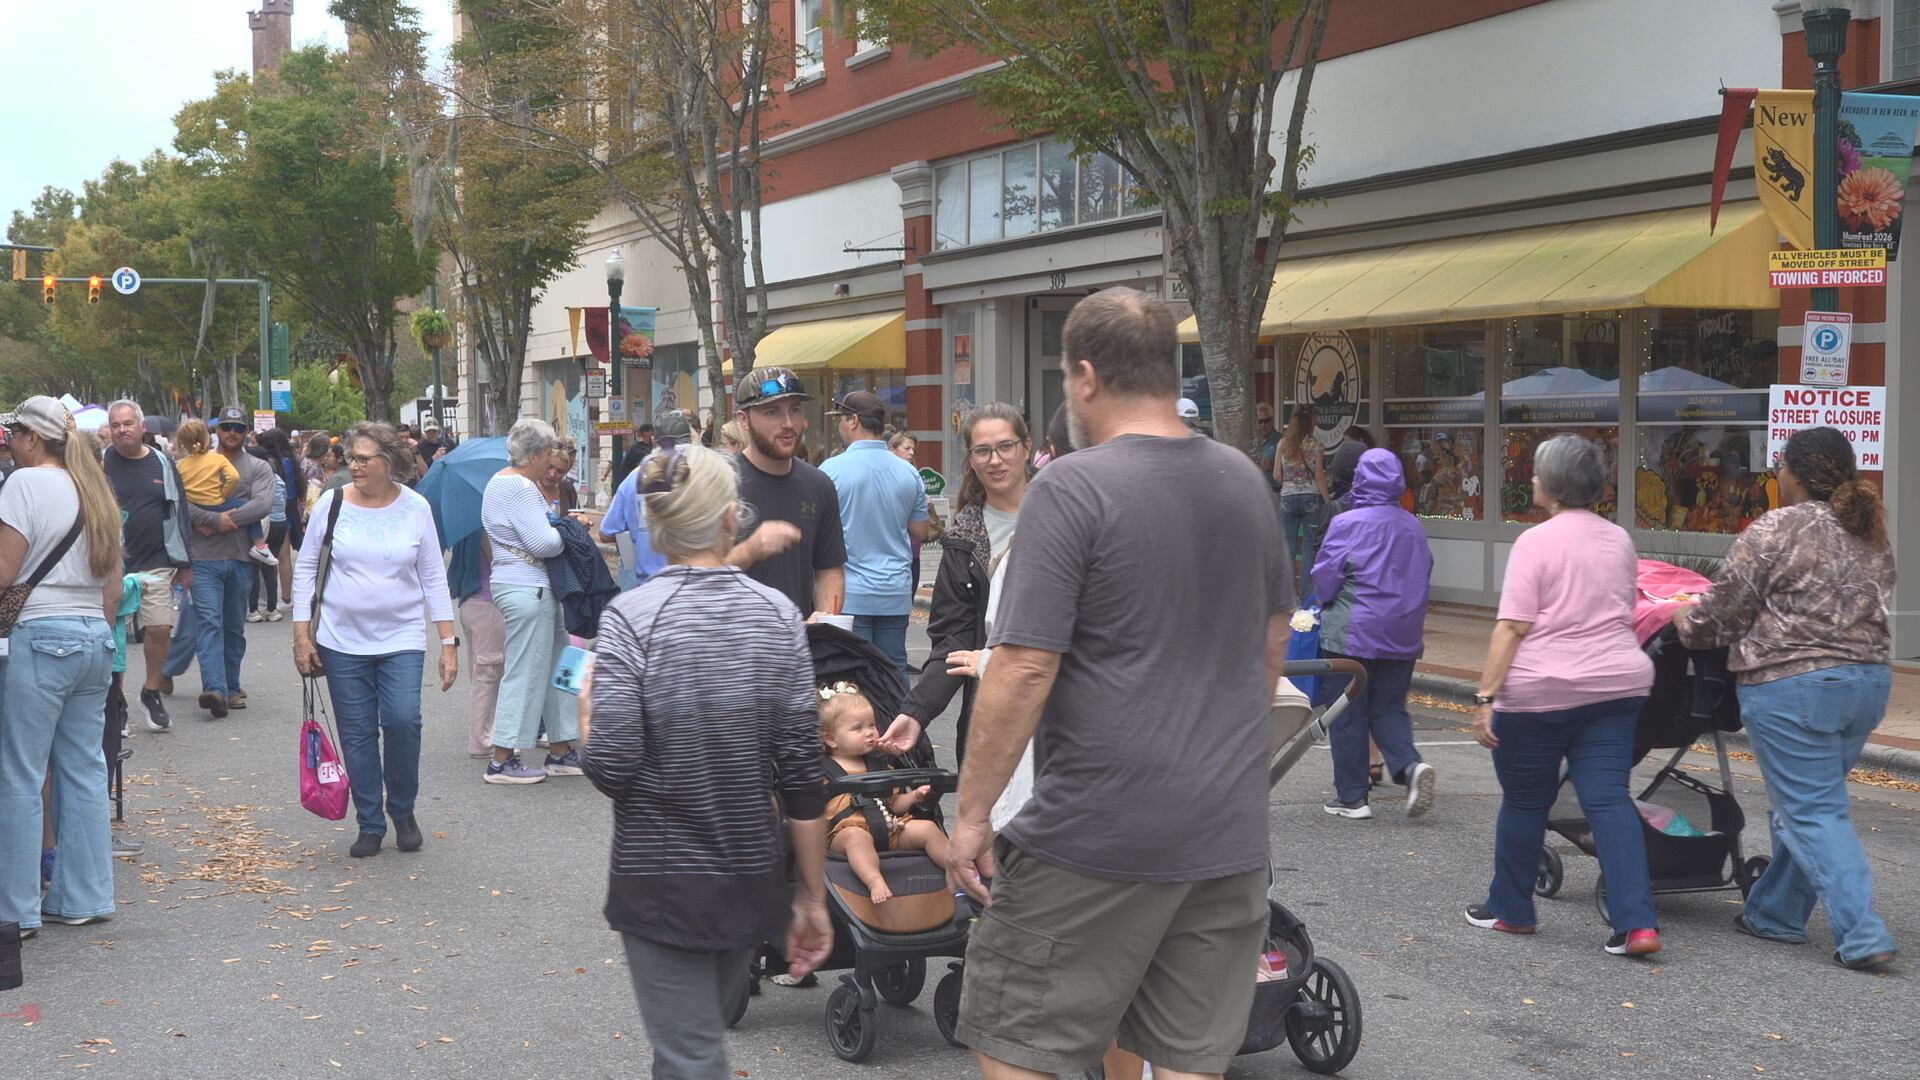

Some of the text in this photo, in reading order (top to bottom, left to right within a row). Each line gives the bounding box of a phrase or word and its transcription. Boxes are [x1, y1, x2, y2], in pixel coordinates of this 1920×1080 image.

[1759, 104, 1808, 127] New
[1871, 107, 1878, 115] IN
[1879, 107, 1891, 116] NEW
[1842, 231, 1893, 242] MumFest 2026
[1791, 251, 1838, 260] VEHICLES
[1840, 250, 1868, 259] MUST
[1870, 249, 1883, 258] BE
[1781, 259, 1876, 269] MOVED OFF STREET
[1050, 272, 1066, 290] 309
[1771, 269, 1883, 286] TOWING ENFORCED
[1805, 355, 1819, 363] FREE
[1784, 389, 1871, 407] NOTICE
[1772, 409, 1881, 426] STREET CLOSURE
[1861, 430, 1880, 443] PM
[1861, 453, 1880, 466] PM
